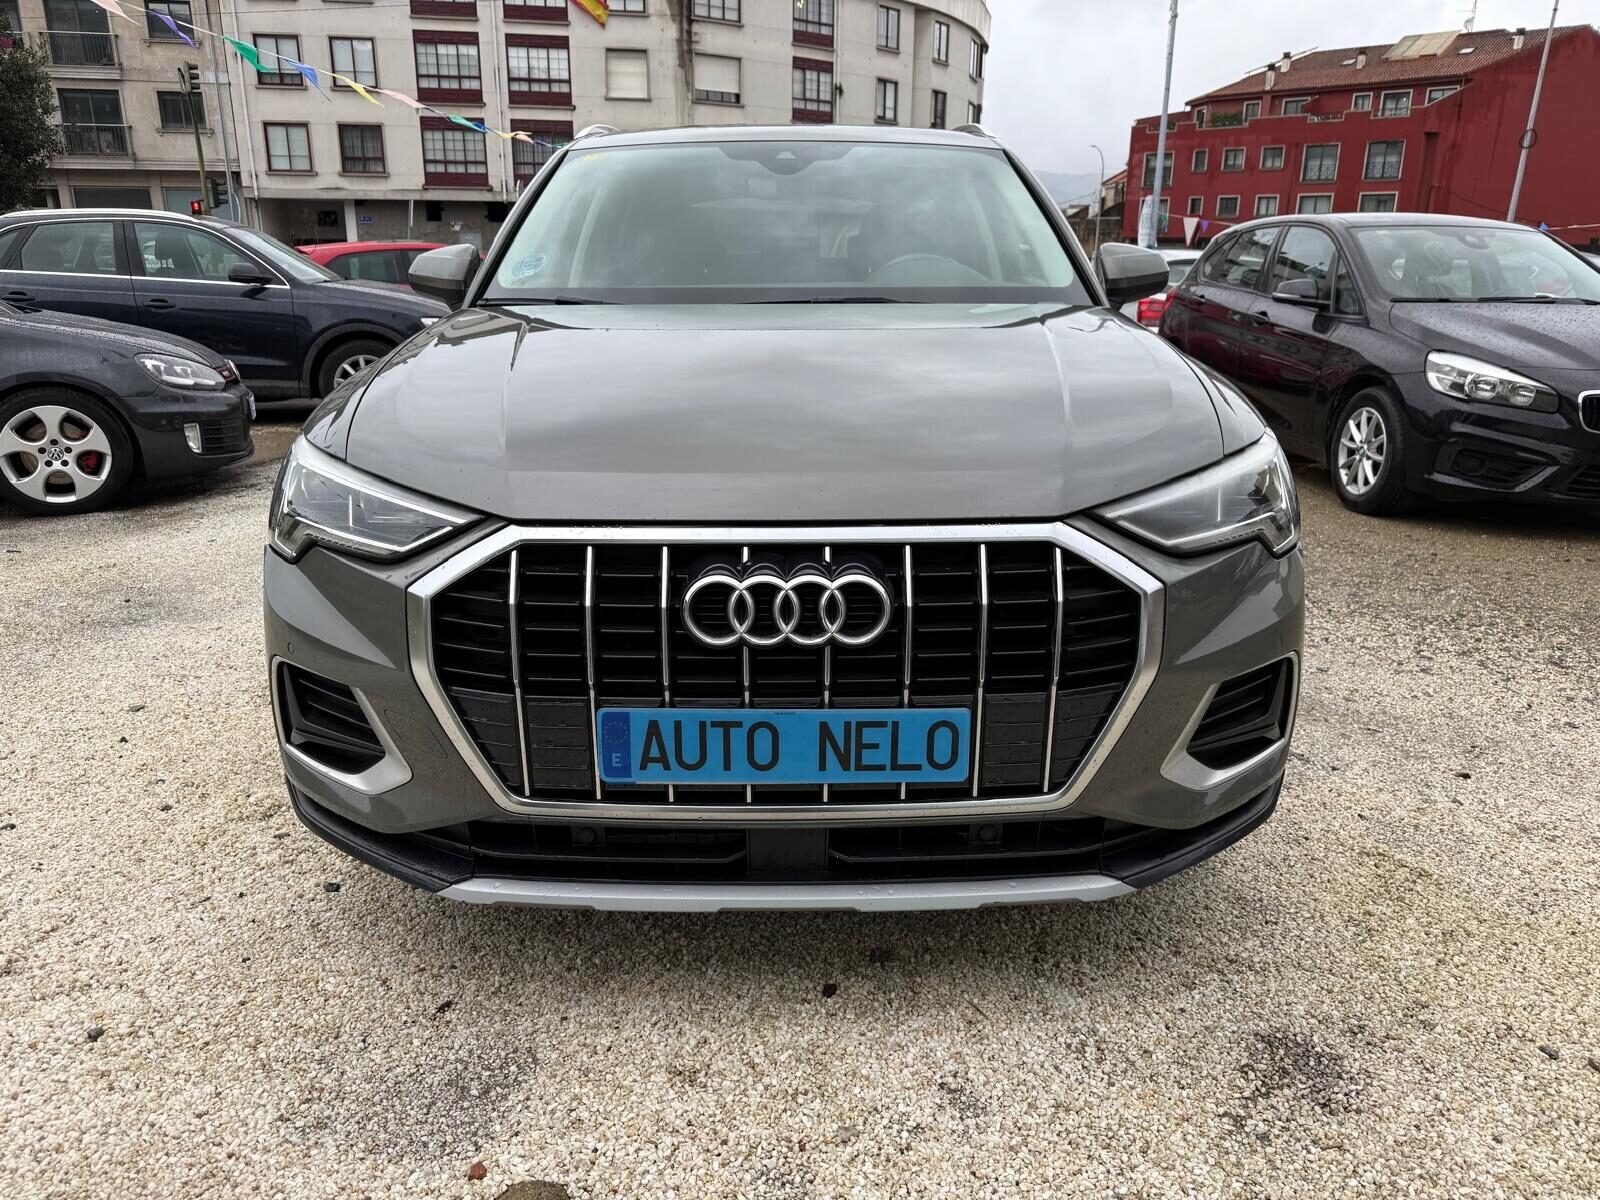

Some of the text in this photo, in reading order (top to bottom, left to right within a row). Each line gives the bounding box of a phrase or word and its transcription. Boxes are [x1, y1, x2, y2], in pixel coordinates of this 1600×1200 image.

[611, 753, 622, 767] E
[639, 720, 960, 771] AUTO NELO
